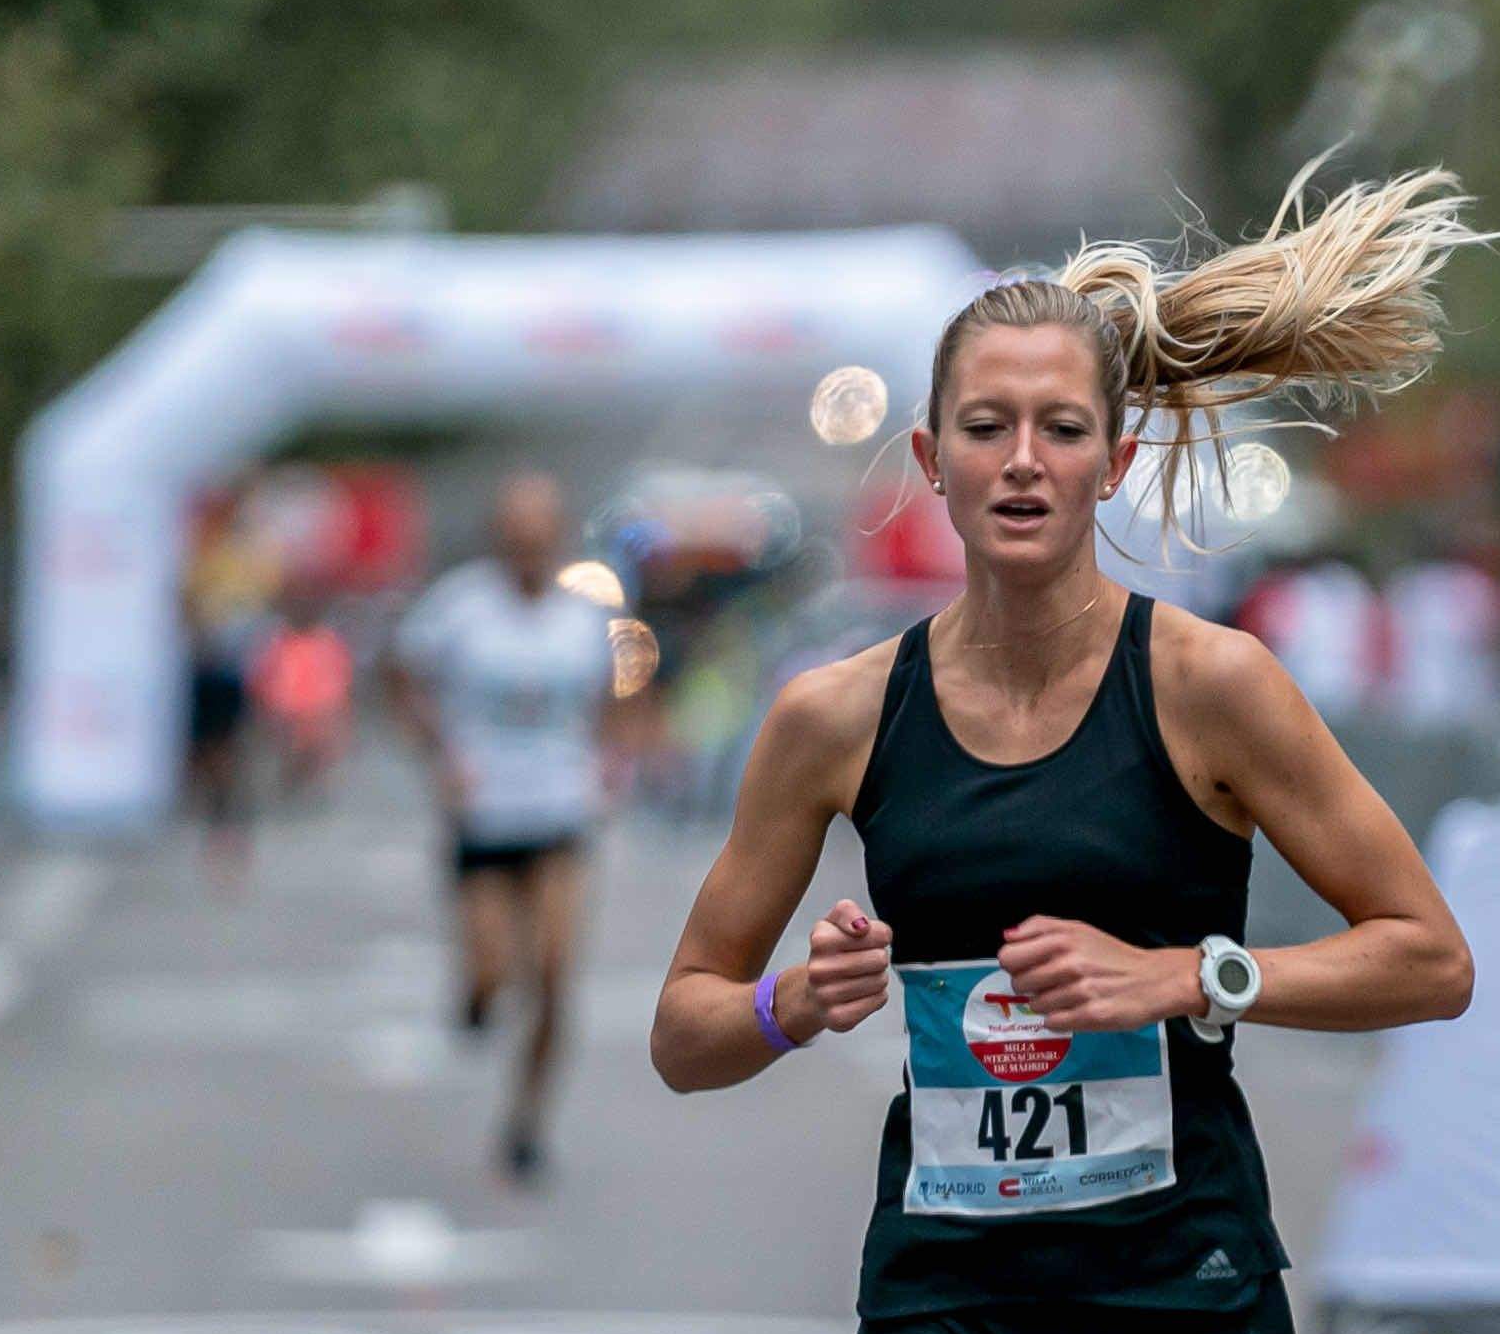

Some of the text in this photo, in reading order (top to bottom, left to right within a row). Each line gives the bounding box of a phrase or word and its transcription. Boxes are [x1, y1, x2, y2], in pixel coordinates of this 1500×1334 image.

[1009, 1061, 1050, 1073] MADRID
[978, 1083, 1088, 1162] 421
[935, 1182, 987, 1196] MADRID
